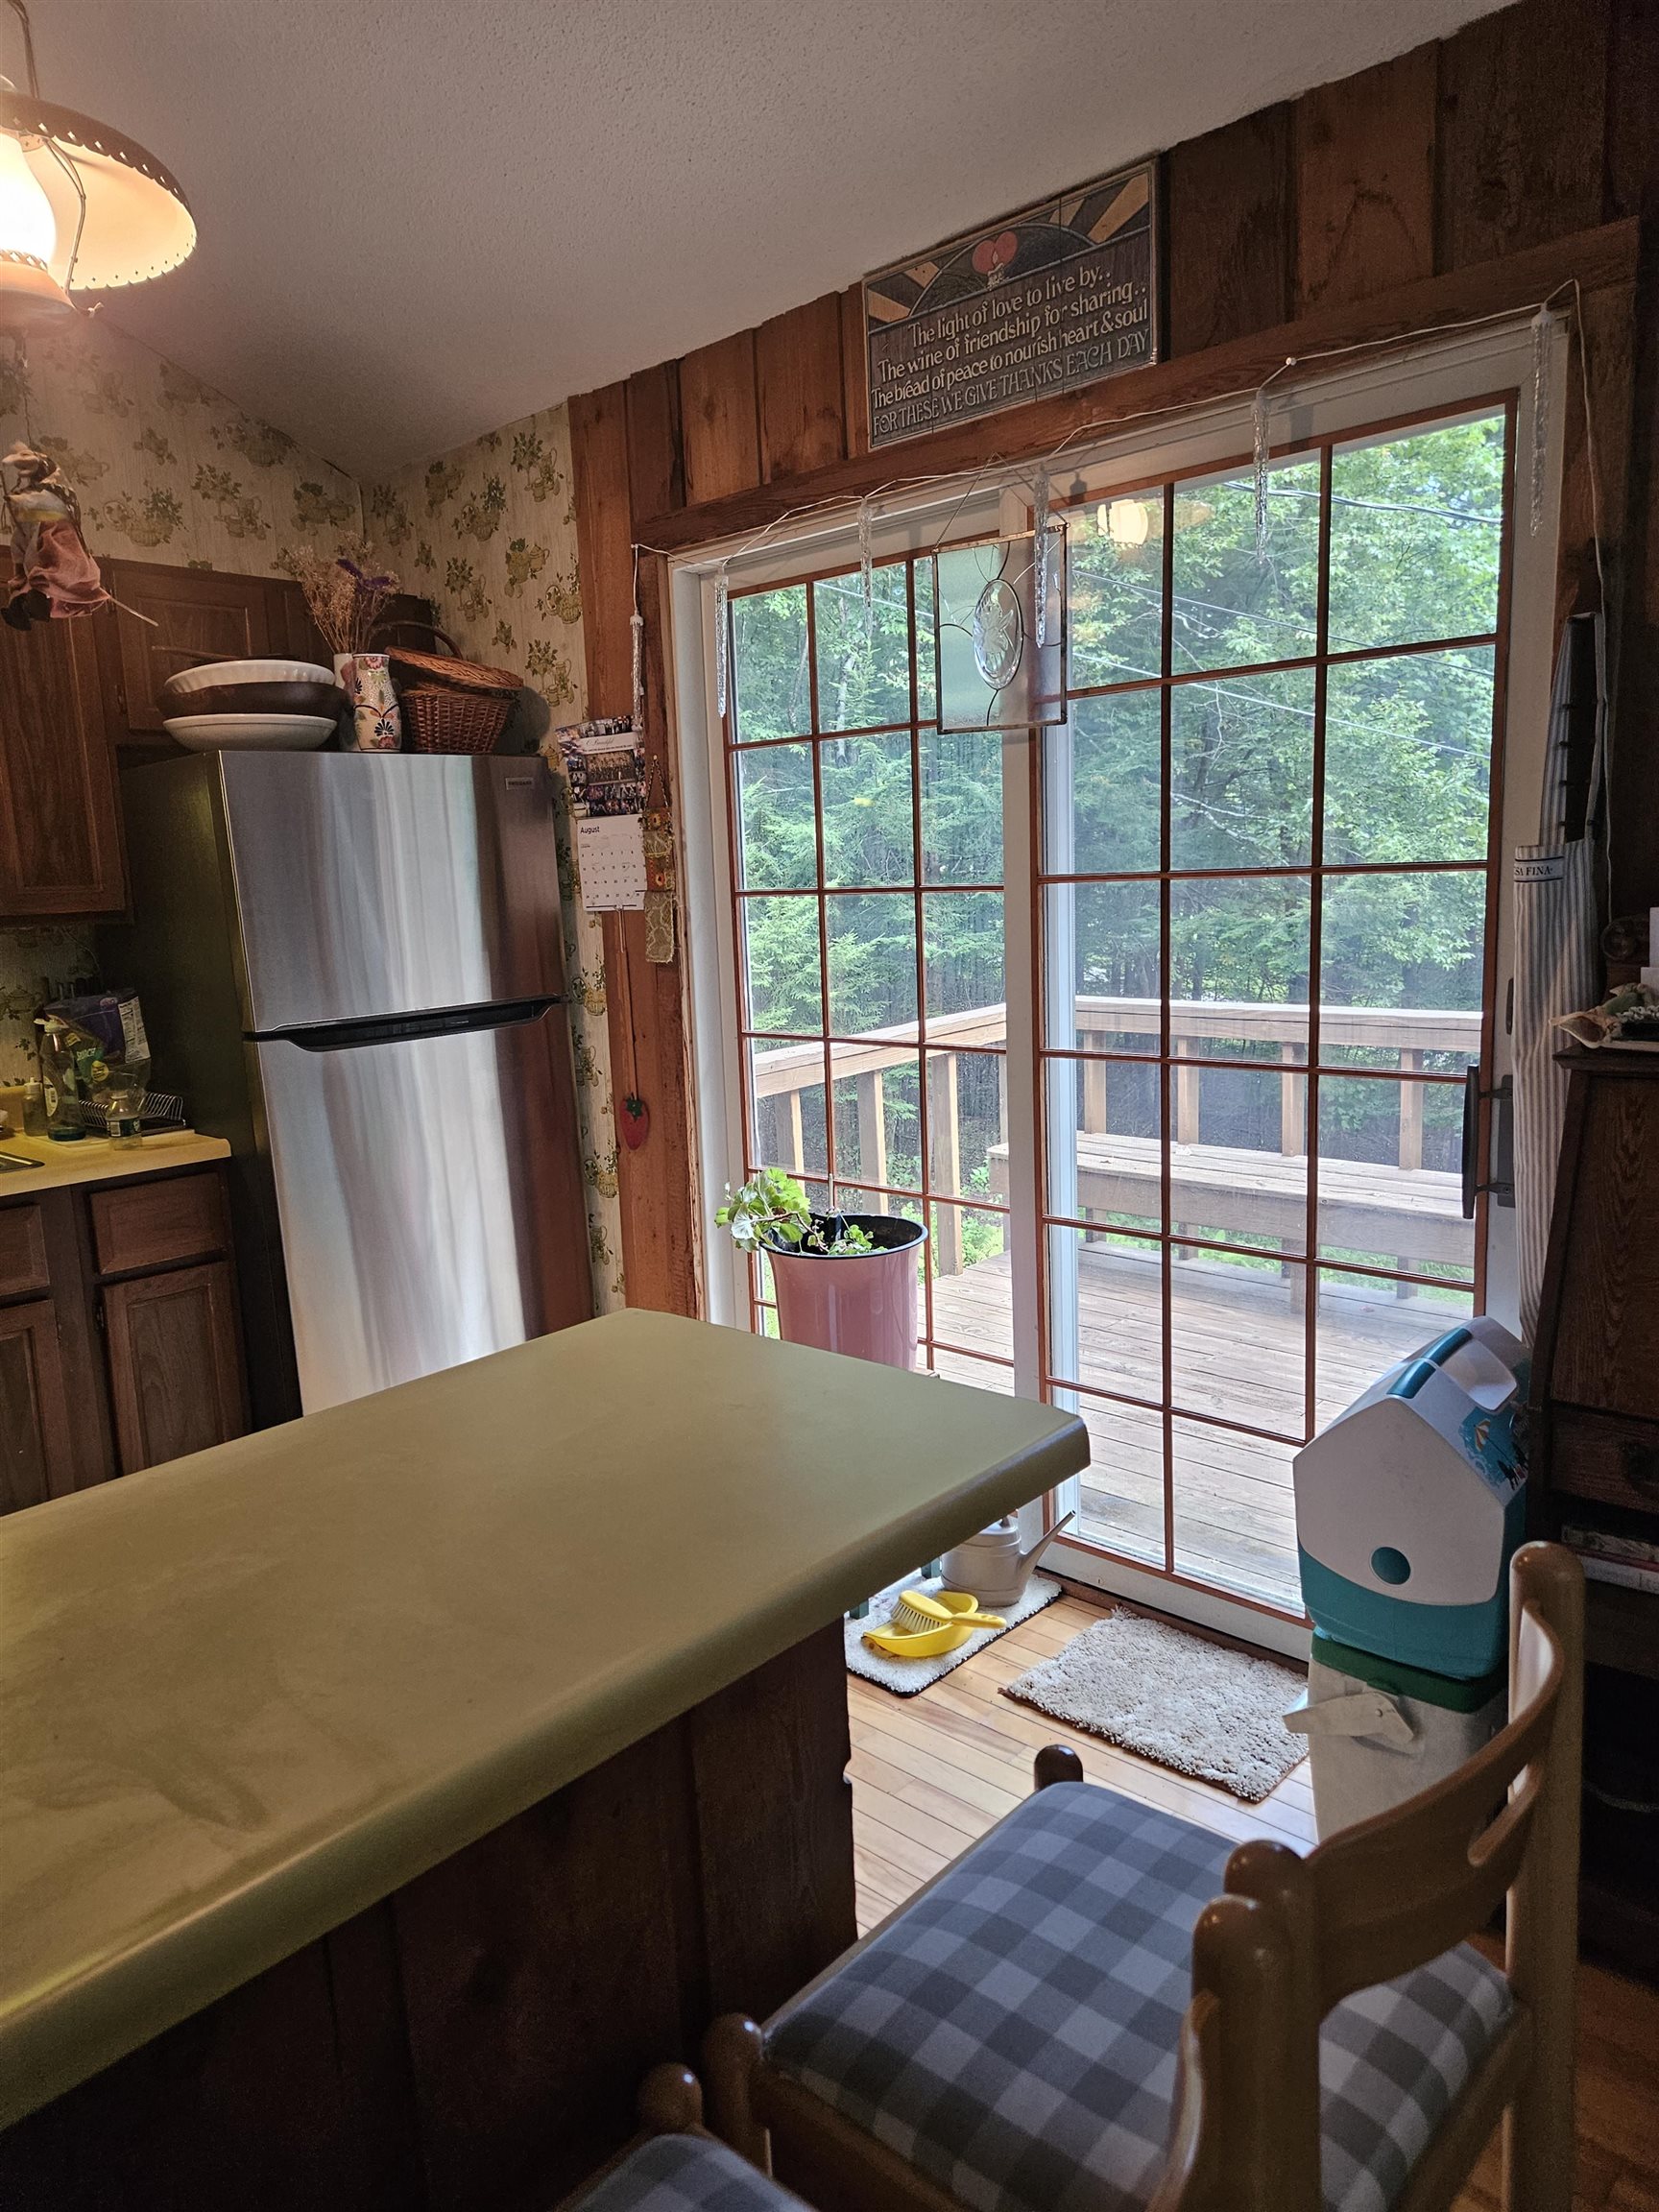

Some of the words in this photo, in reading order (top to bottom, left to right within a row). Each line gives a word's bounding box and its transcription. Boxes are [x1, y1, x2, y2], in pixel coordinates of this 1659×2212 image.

[878, 358, 904, 383] The
[907, 349, 943, 373] wine
[946, 337, 960, 361] of
[964, 312, 1041, 354] friendship
[1045, 304, 1068, 326] for
[908, 321, 935, 348] The
[937, 312, 970, 340] light
[973, 301, 988, 326] of
[992, 296, 1022, 320] love
[1026, 286, 1042, 306] to
[1046, 276, 1075, 300] live
[872, 387, 894, 409] The
[895, 374, 929, 401] bread
[931, 369, 946, 391] of
[947, 359, 988, 391] peace
[990, 353, 1002, 371] to
[1005, 331, 1057, 366] nourish
[1059, 322, 1099, 349] heart
[1100, 310, 1114, 333] &
[1115, 298, 1147, 329] soul
[874, 411, 898, 436] FOR
[899, 397, 939, 429] THESE
[941, 390, 963, 415] WE
[965, 378, 998, 405] GIVE
[999, 358, 1063, 397] THANKS
[1067, 341, 1113, 375] EACH
[1117, 328, 1149, 359] DAY
[580, 826, 600, 835] August
